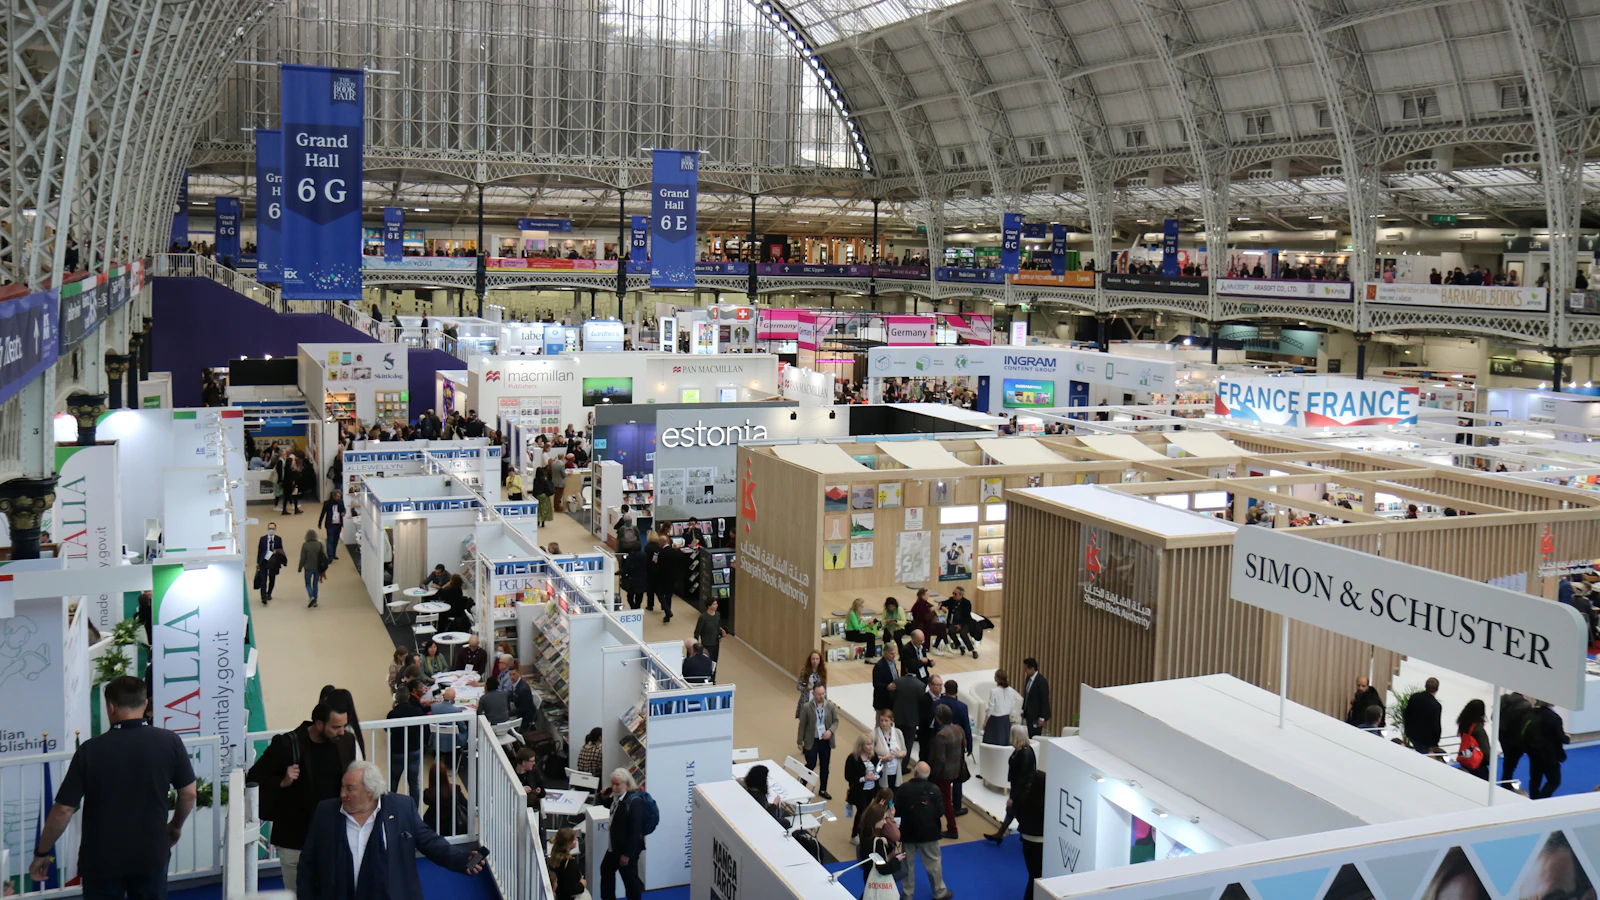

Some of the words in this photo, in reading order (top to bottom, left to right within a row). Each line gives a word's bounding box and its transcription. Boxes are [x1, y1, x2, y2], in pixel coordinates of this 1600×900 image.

[333, 86, 356, 94] BOOK
[333, 92, 356, 100] FAIR
[296, 132, 348, 148] Grand
[304, 153, 340, 168] Hall
[298, 177, 316, 202] 6
[324, 178, 348, 204] G
[660, 188, 690, 198] Grand
[664, 201, 684, 210] Hall
[660, 215, 672, 230] 6
[676, 216, 688, 230] E
[228, 228, 235, 236] G
[388, 232, 393, 240] 6
[394, 232, 400, 240] E
[1005, 242, 1010, 250] 6
[1011, 242, 1017, 250] C
[1166, 246, 1170, 254] 6
[1170, 246, 1176, 254] B
[1529, 241, 1541, 249] Lift
[284, 270, 298, 278] RX
[1254, 284, 1276, 292] ARASOFT
[1276, 284, 1286, 293] CO.,
[1441, 286, 1523, 308] BARAMGILBOOKS
[764, 322, 798, 330] Germany
[891, 328, 928, 338] Germany
[1004, 356, 1056, 368] INGRAM
[682, 366, 697, 374] PAN
[698, 365, 744, 374] MACMILLAN
[1510, 364, 1522, 374] Lift
[508, 370, 574, 382] macmillan
[790, 382, 800, 391] PAN
[800, 384, 829, 399] MACMILLAN
[1218, 382, 1300, 415] FRANCE
[1308, 390, 1410, 417] FRANCE
[662, 418, 768, 448] estonia
[350, 463, 404, 471] LLEWELLYN
[500, 578, 534, 590] PGUK
[740, 557, 762, 582] Sharjah
[762, 570, 778, 590] Book
[778, 577, 809, 610] Authority
[1084, 594, 1105, 610] Sharjah
[1105, 602, 1120, 616] Book
[1120, 608, 1150, 630] Authority
[1244, 552, 1334, 602] SIMON
[1339, 580, 1365, 611] &
[1370, 588, 1553, 670] SCHUSTER
[620, 614, 642, 623] 6E30
[686, 760, 696, 778] UK
[712, 836, 737, 870] MANGA
[712, 862, 737, 900] TAROT
[868, 882, 893, 890] BOOKBAR
